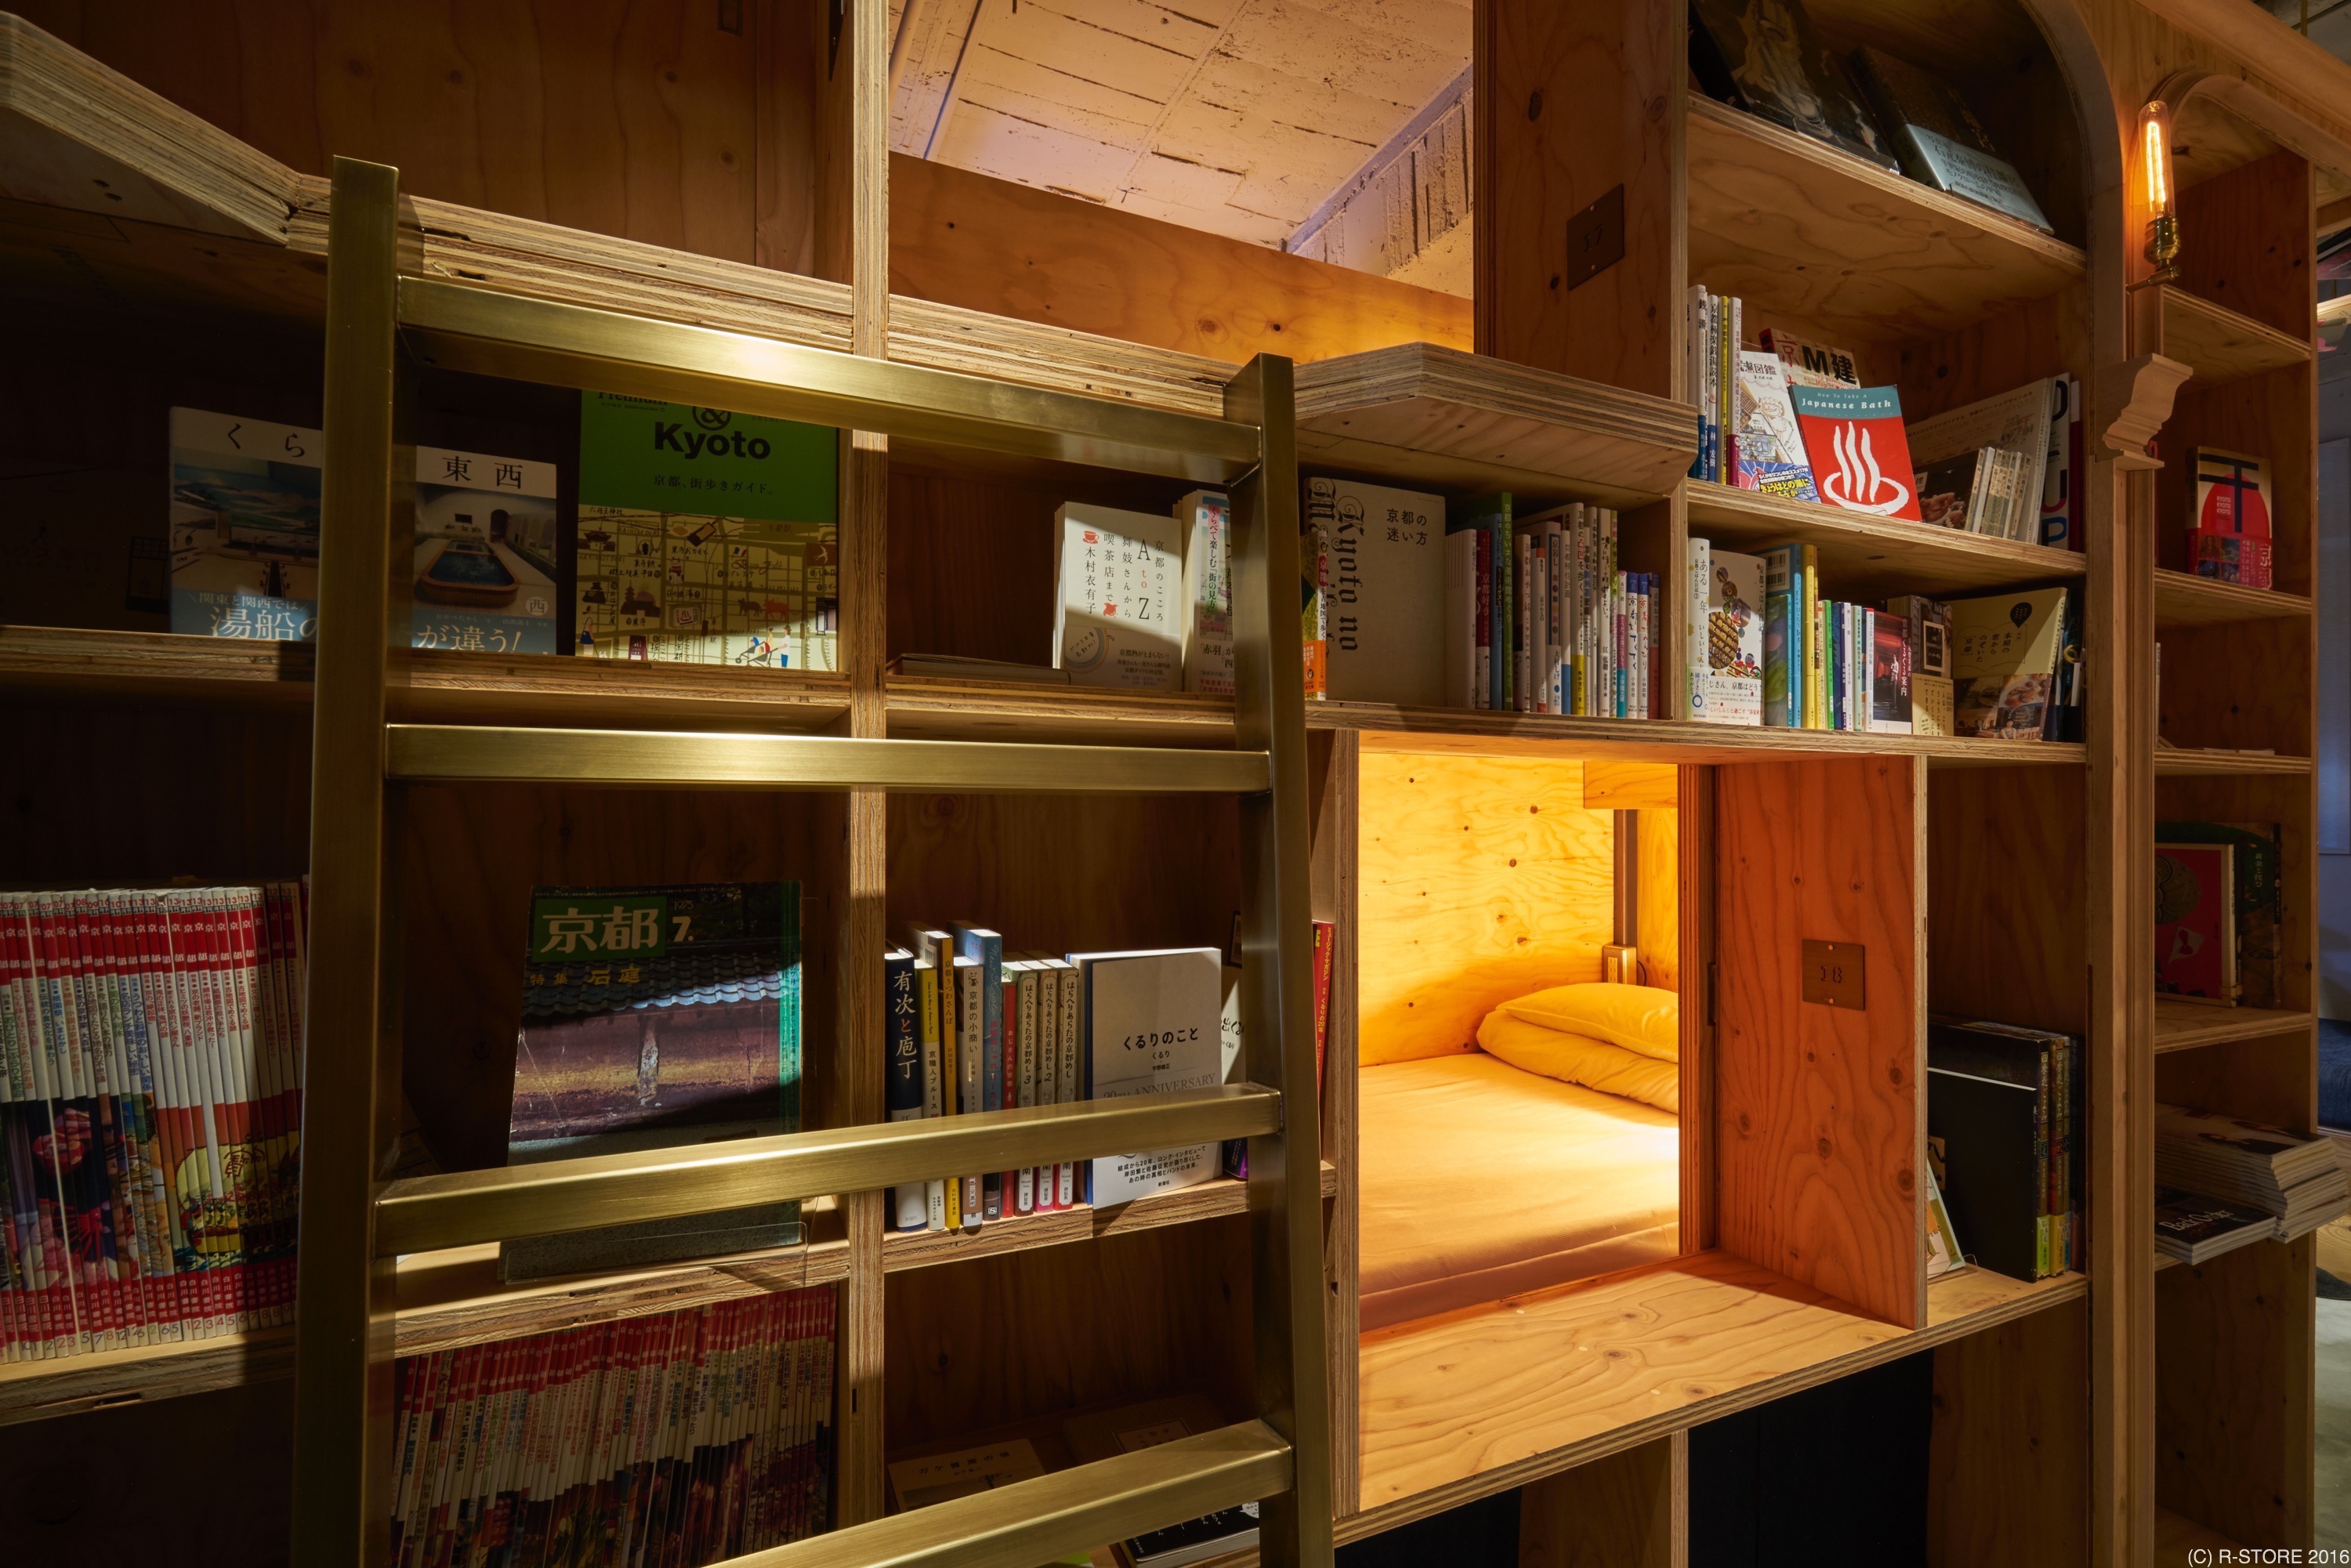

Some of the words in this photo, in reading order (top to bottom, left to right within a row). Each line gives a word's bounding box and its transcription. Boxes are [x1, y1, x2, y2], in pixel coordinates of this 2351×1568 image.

[1802, 397, 1855, 409] Japanese
[1861, 400, 1892, 408] Bath
[654, 422, 770, 459] Kyoto
[443, 455, 523, 489] 東西
[654, 473, 774, 495] 京都、街歩きガイド。
[1386, 506, 1428, 527] 京都の
[1386, 526, 1428, 546] 迷い方
[1137, 539, 1150, 560] A
[1208, 506, 1218, 614] くらべて楽しむ「街の見方」
[1332, 495, 1364, 604] Kyoto
[1103, 534, 1114, 602] 喫茶店まで
[1122, 535, 1133, 617] 舞妓さんから
[1141, 570, 1147, 588] to
[1085, 546, 1096, 614] 木村衣有子
[1154, 540, 1165, 621] 京都のこころ
[1699, 559, 1708, 614] ある一年
[200, 592, 298, 610] 関東と関西では
[530, 599, 546, 614] 西
[1139, 597, 1150, 620] Z
[1976, 635, 1987, 663] のぞいた
[2002, 632, 2012, 653] 本屋の
[673, 900, 694, 910] 1975
[540, 905, 658, 954] 京都
[1323, 926, 1332, 981] ミュージック・マガジン
[530, 972, 569, 986] 特集
[587, 966, 641, 986] 石庭
[893, 970, 918, 1080] 有次と庖丁
[969, 990, 978, 1054] 京都の小商い
[1317, 998, 1326, 1034] くるりの20年
[1024, 984, 1034, 1073] はらへりあらたの京都めし
[1044, 983, 1054, 1072] はらへりあらたの京都めし
[1066, 981, 1076, 1079] はらへりあらたの京都めし
[1123, 1027, 1199, 1051] くるりのこと
[1152, 1050, 1170, 1060] くるり
[928, 1050, 938, 1110] 京職人ブルース
[1023, 1074, 1031, 1085] 3
[1044, 1072, 1052, 1083] 2
[186, 1320, 190, 1330] 1
[193, 1320, 201, 1330] 2
[205, 1319, 214, 1329] 3
[216, 1316, 224, 1326] 4
[226, 1316, 234, 1326] 5
[56, 1337, 67, 1348] 2
[81, 1333, 90, 1344] 5
[94, 1334, 103, 1345] 7
[918, 1450, 1010, 1475] ガケ書房の頃
